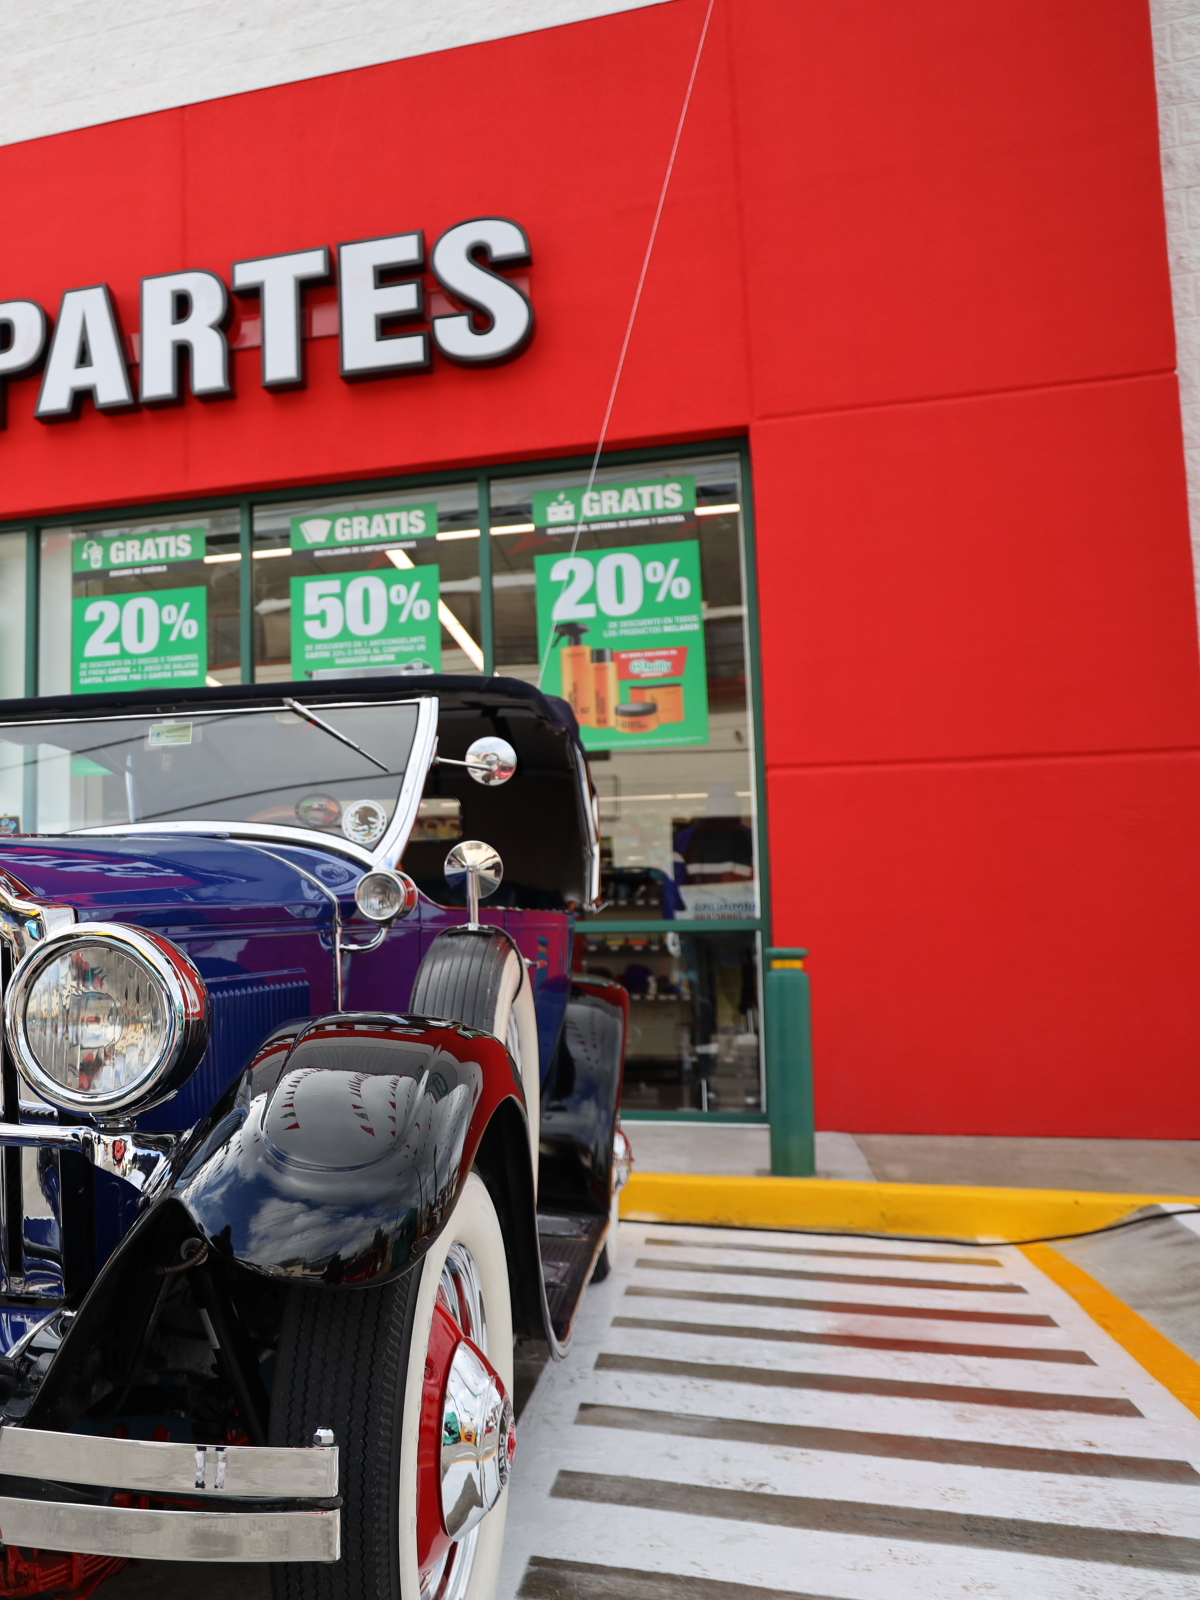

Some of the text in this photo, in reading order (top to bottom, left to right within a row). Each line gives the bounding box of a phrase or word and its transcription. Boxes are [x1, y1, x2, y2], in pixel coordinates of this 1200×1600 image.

[582, 483, 683, 517] GRATIS
[109, 534, 192, 564] GRATIS
[335, 510, 426, 542] GRATIS
[303, 575, 431, 639] 50%
[549, 552, 691, 621] 20%
[84, 597, 198, 658] 20%
